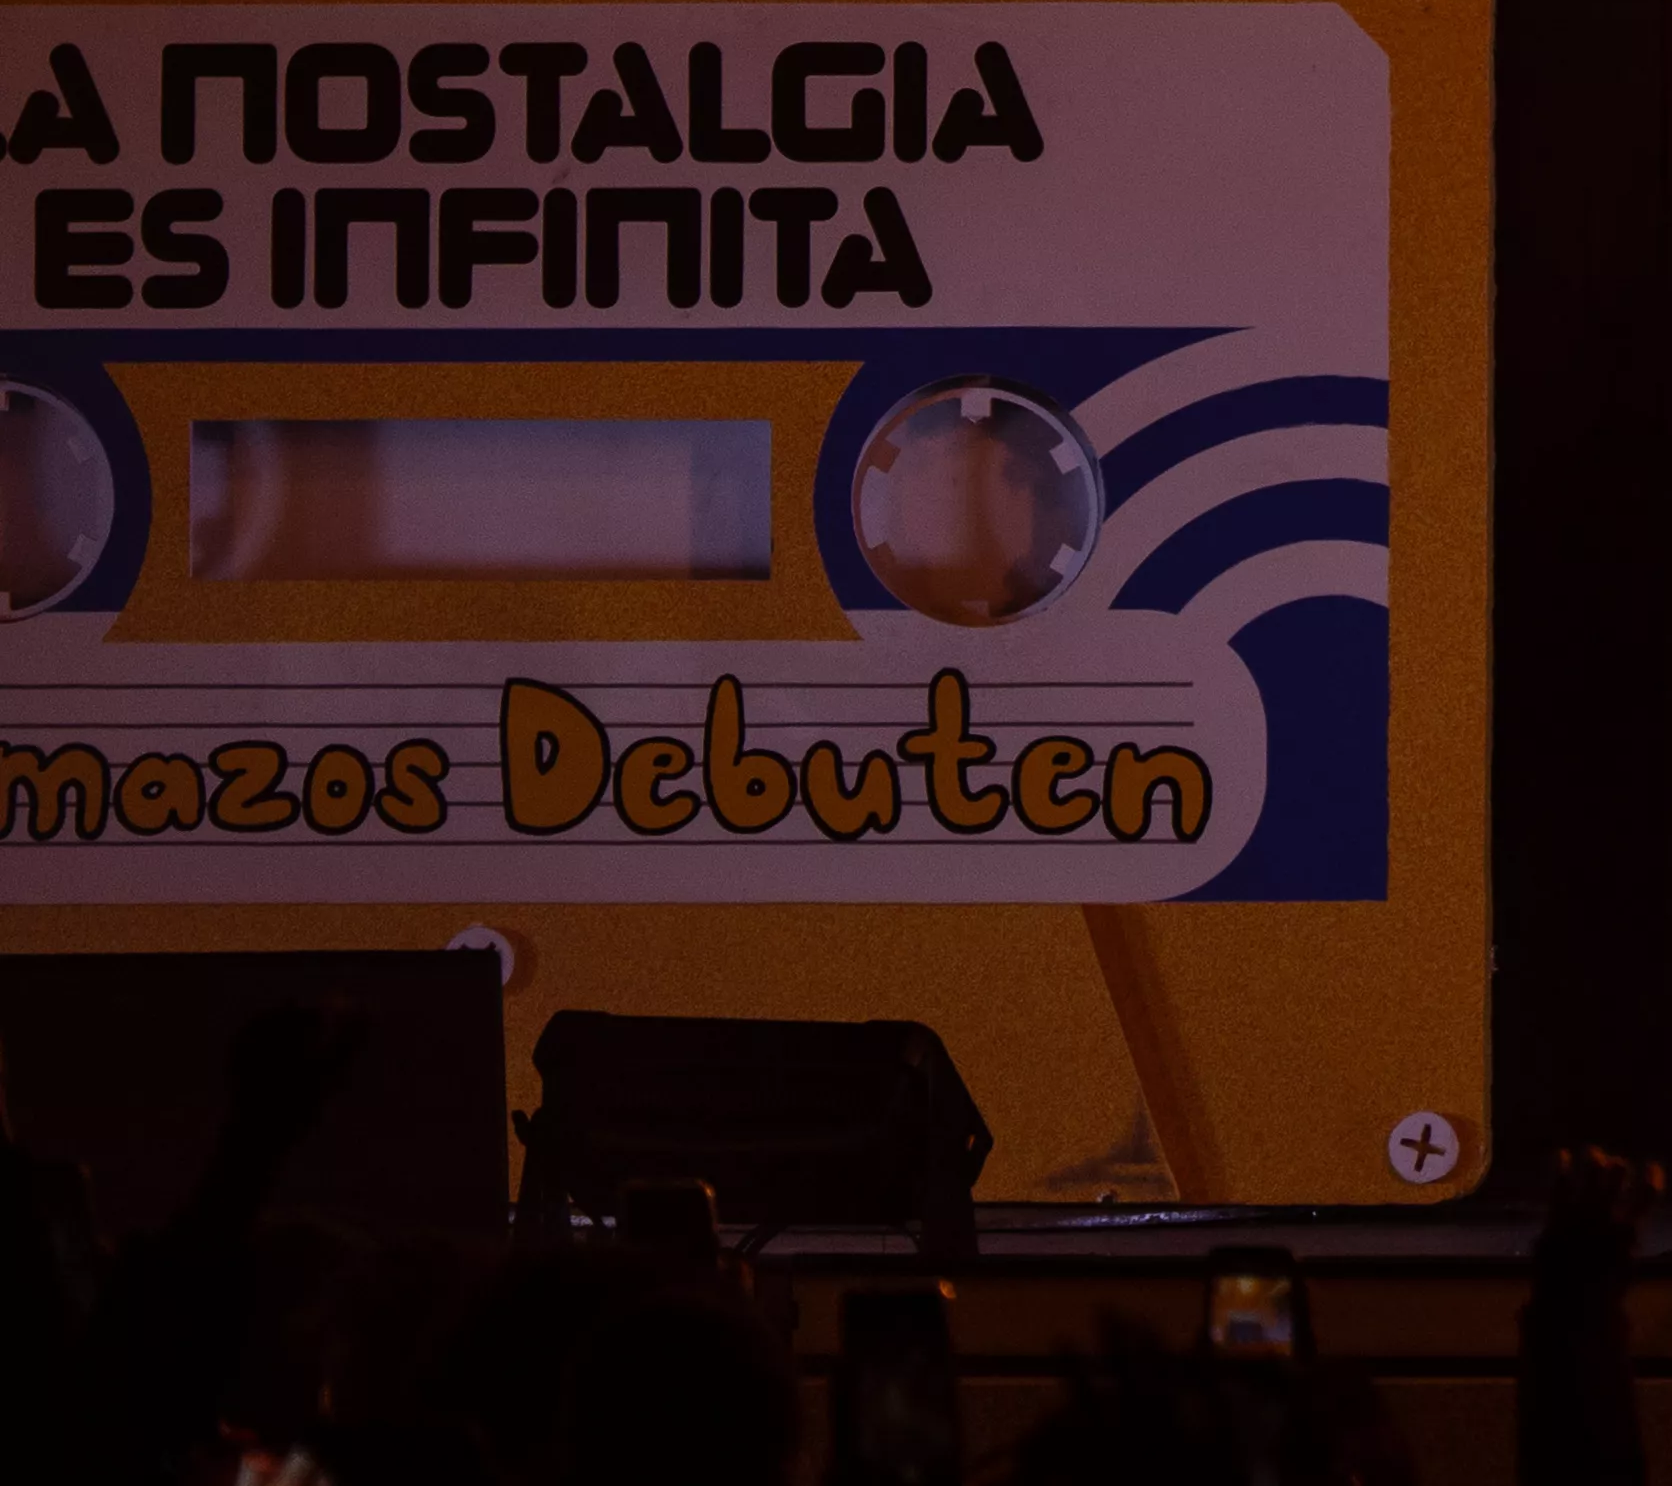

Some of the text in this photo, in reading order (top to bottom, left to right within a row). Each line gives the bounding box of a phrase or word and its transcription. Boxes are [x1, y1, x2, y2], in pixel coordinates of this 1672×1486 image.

[0, 41, 1044, 165] A NOSTALGIA
[34, 186, 934, 310] ES INFINITA
[500, 667, 1213, 842] Debuten
